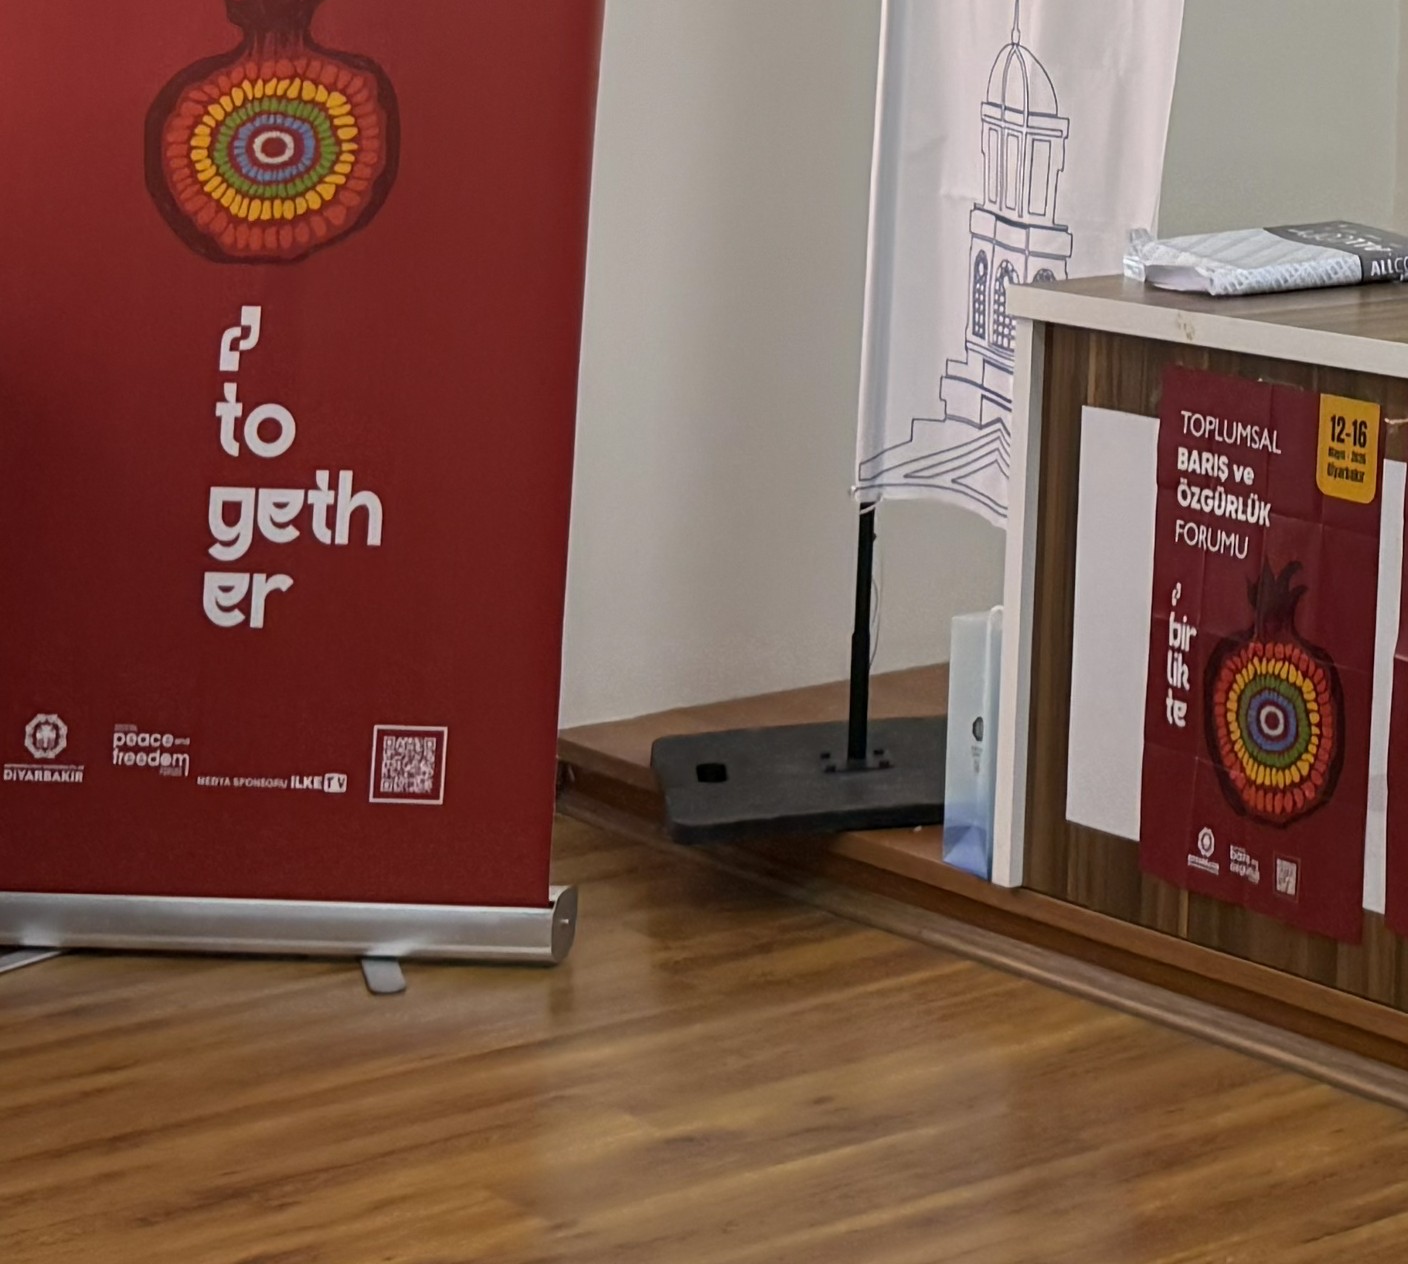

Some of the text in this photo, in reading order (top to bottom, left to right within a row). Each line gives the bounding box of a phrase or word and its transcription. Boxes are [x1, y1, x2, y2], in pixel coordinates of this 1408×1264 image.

[215, 382, 296, 458] to
[1181, 411, 1281, 454] TOPLUMSAL
[1330, 414, 1368, 448] 12-16
[1178, 447, 1254, 485] BARIŞ ve
[208, 469, 383, 561] geth
[1177, 478, 1271, 527] ÖZGÜRLÜK
[1175, 520, 1248, 559] FORUMU
[202, 571, 294, 628] er
[1169, 612, 1196, 651] bir
[1167, 650, 1190, 690] lik
[1166, 689, 1187, 727] te
